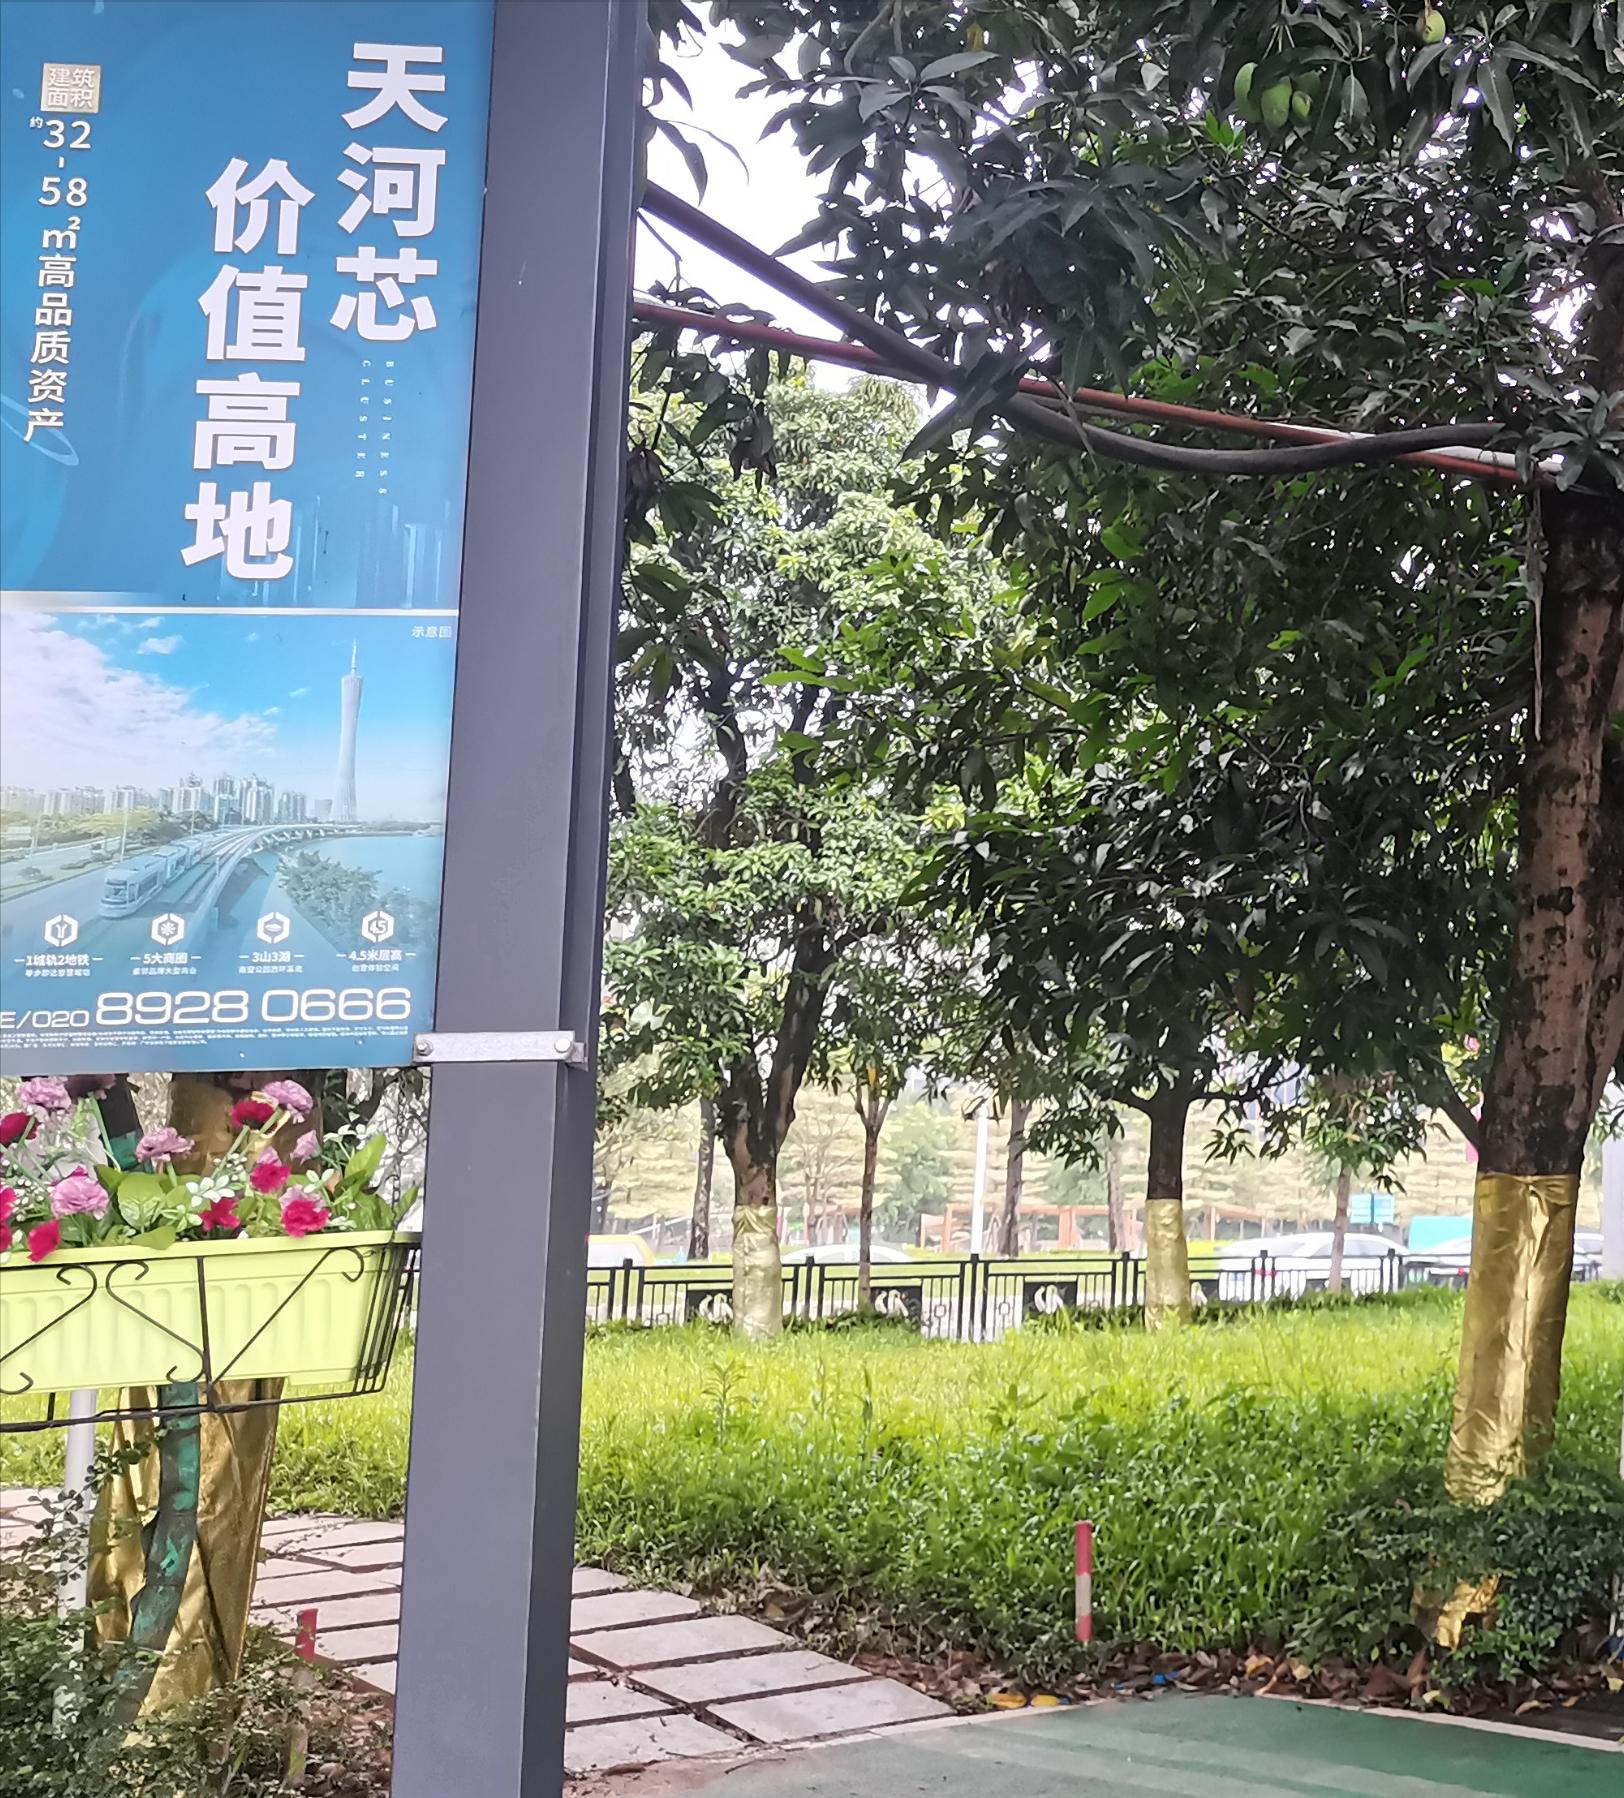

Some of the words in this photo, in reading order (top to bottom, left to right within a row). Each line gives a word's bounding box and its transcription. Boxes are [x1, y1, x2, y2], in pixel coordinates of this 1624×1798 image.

[329, 42, 448, 342] 天河芯
[181, 157, 315, 580] 价值高地
[95, 990, 249, 1026] 8928
[261, 987, 412, 1022] 0666
